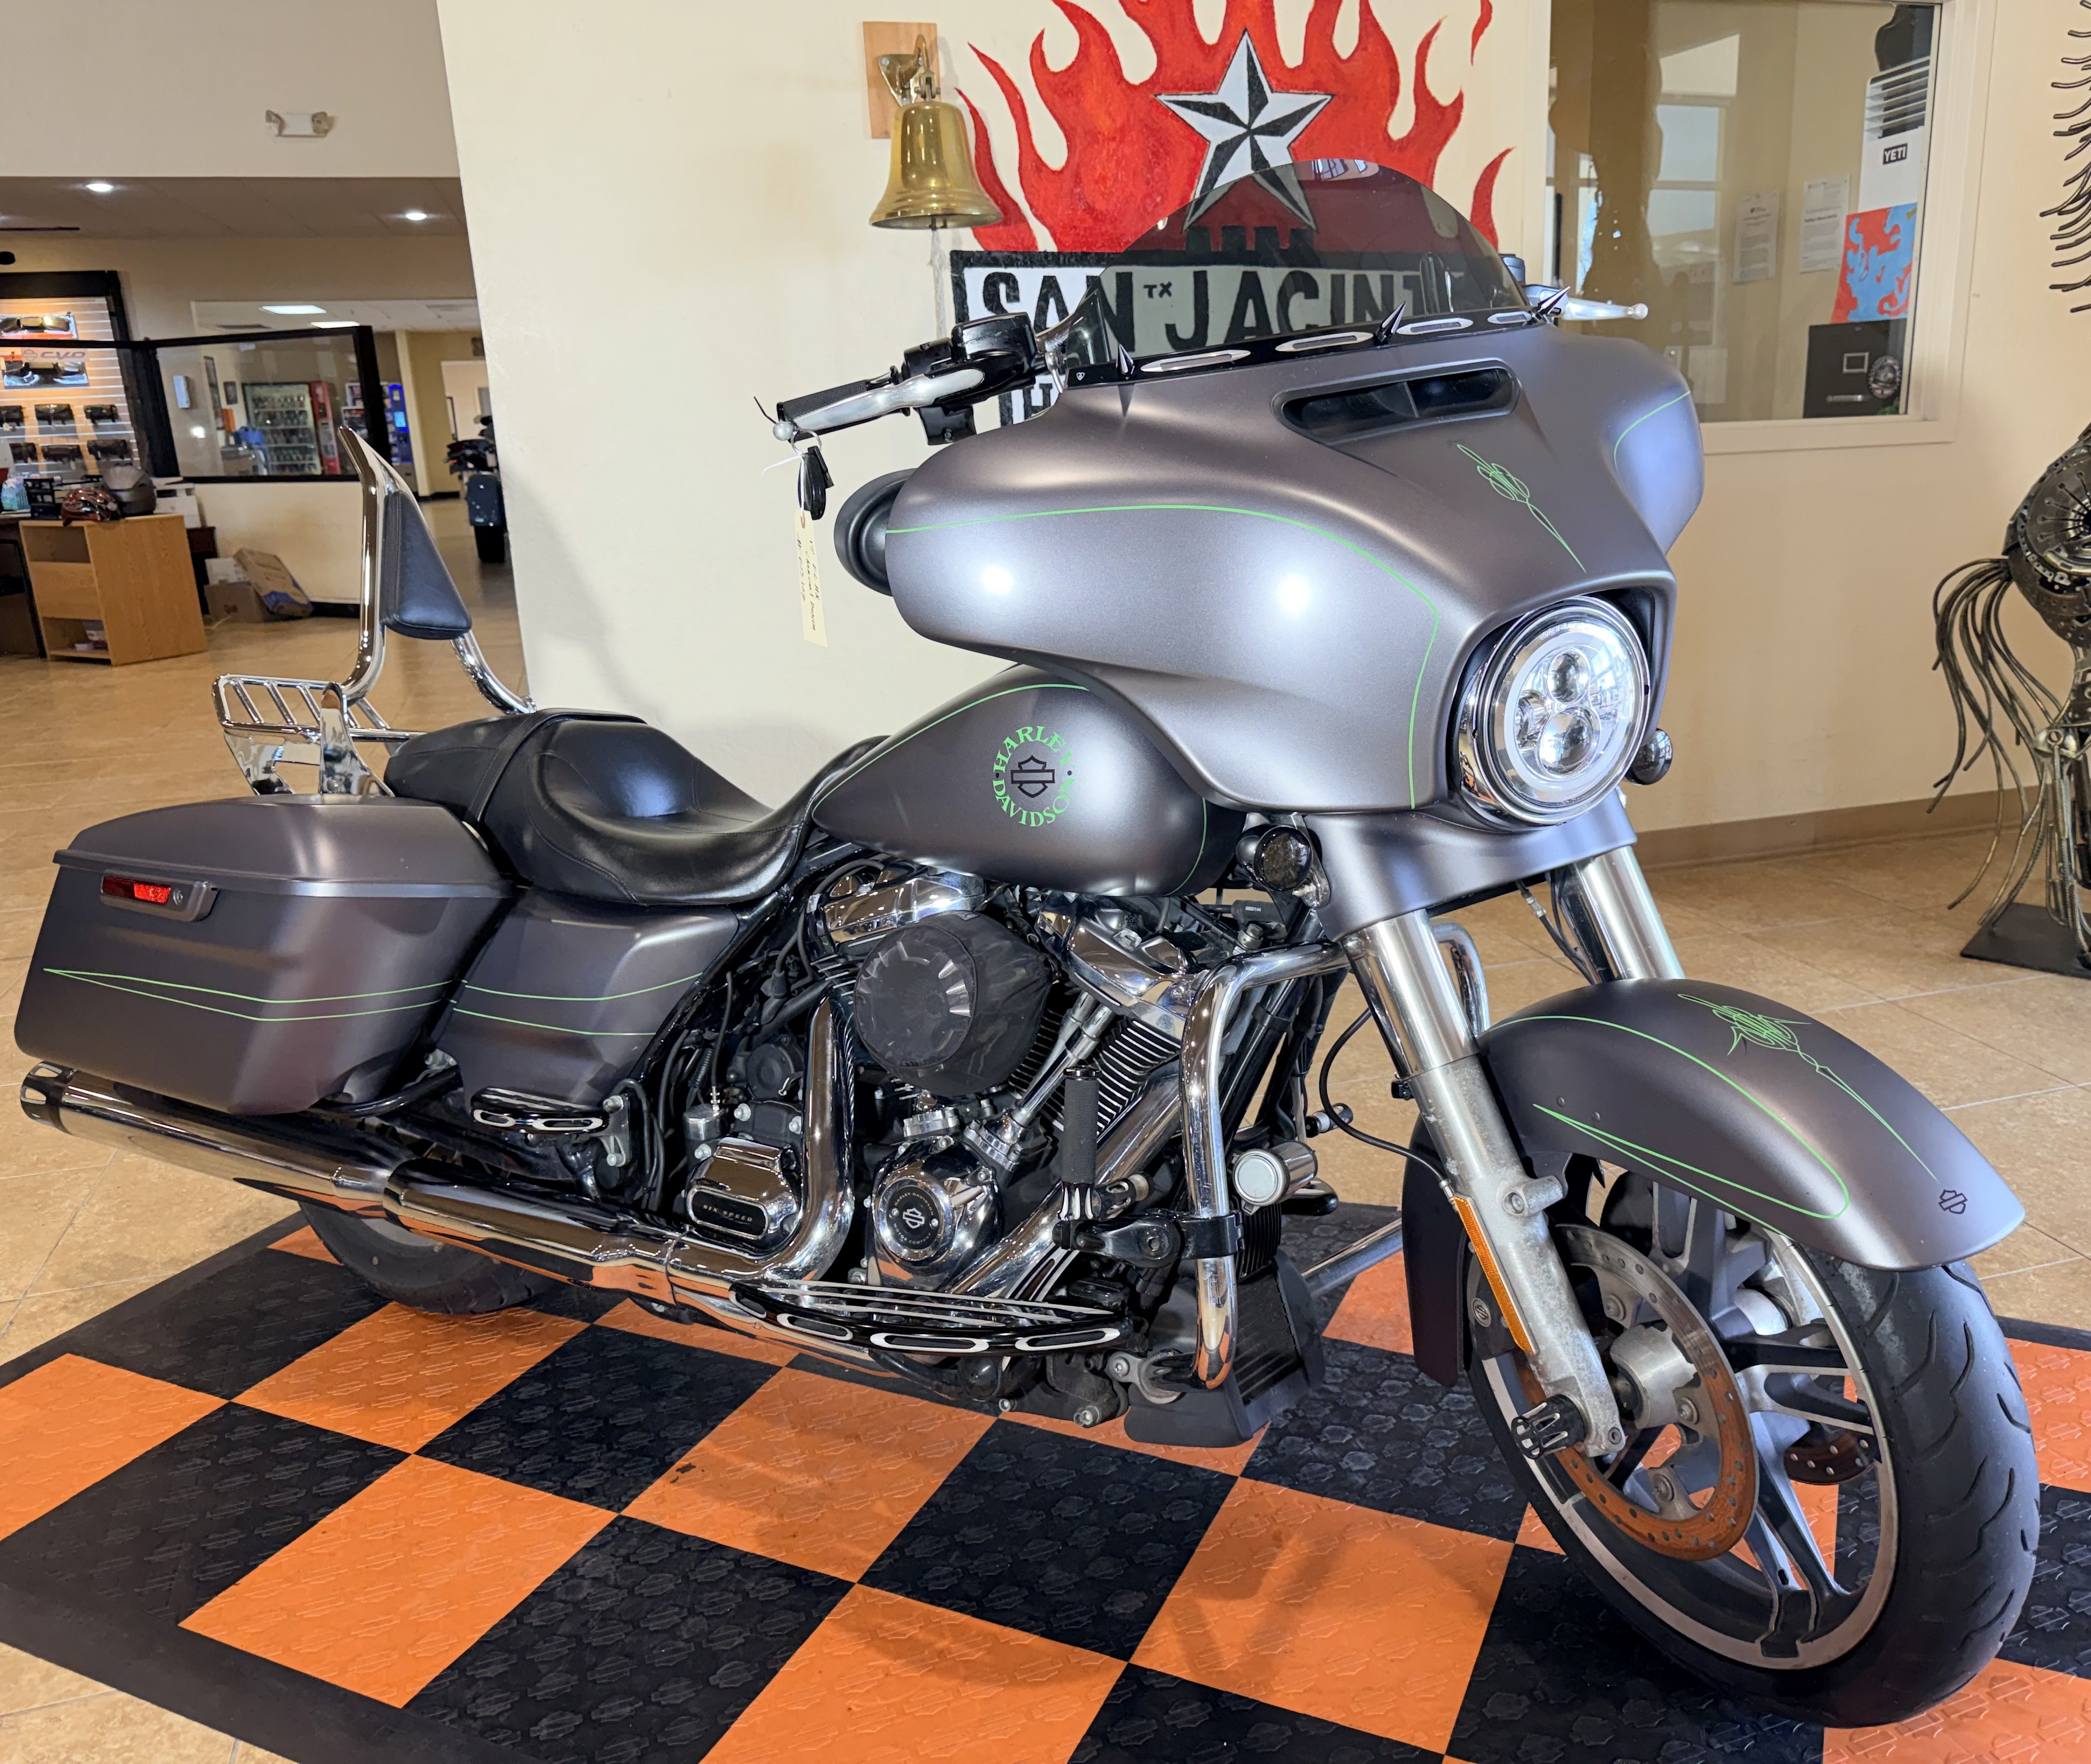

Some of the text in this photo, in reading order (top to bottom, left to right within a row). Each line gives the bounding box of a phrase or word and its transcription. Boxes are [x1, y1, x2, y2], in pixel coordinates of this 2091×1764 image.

[1884, 145, 1907, 162] YETI
[1144, 282, 1173, 299] TX
[40, 351, 86, 359] CVO
[993, 725, 1077, 773] HARLEY
[992, 776, 1077, 827] DAVIDSON
[702, 1204, 753, 1222] SIX SPEED
[893, 1223, 932, 1244] MOTOR COMPANY
